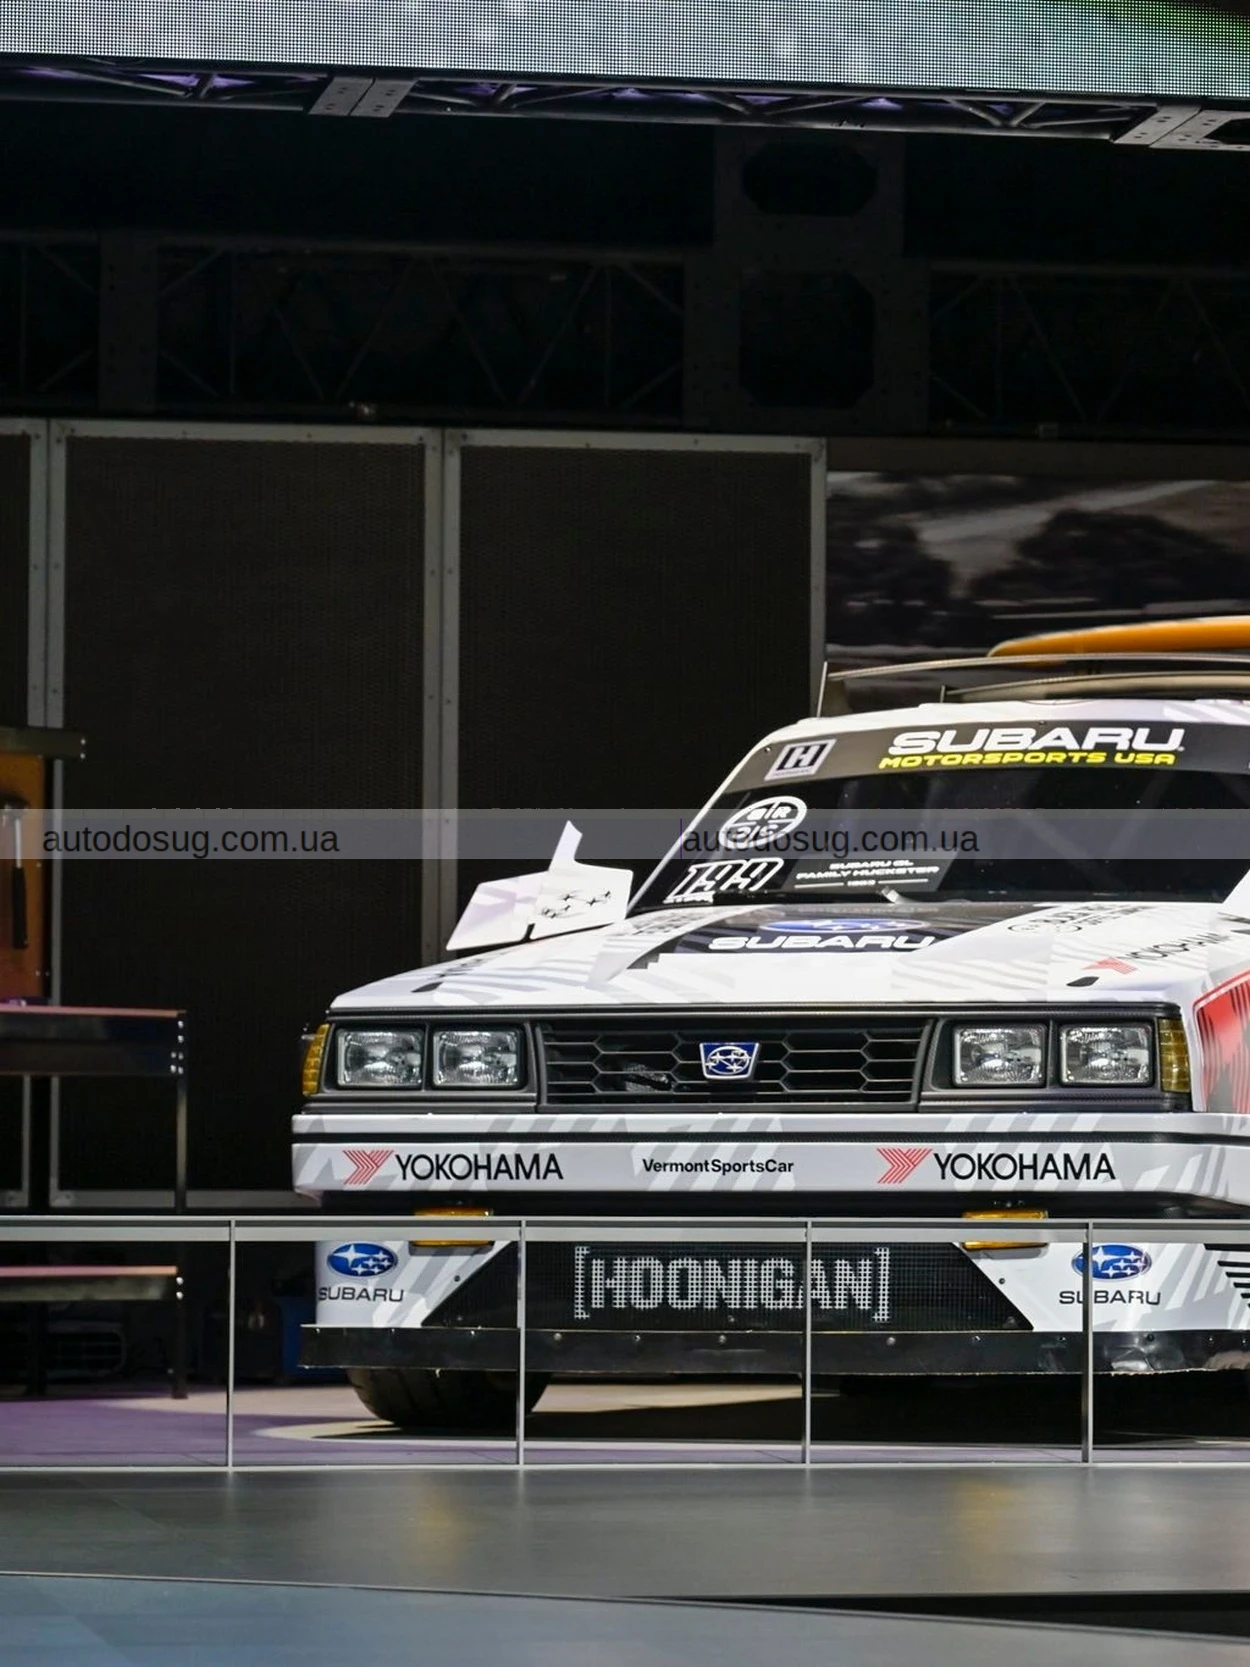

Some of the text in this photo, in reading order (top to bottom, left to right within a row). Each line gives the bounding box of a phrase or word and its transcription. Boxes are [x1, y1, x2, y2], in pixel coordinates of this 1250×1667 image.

[888, 727, 1184, 755] SUBARU
[878, 751, 1176, 769] MOTORSPORTS USA
[795, 869, 851, 879] FAMILY
[708, 934, 936, 951] SUBARU
[395, 1152, 564, 1181] YOKOHAMA
[933, 1152, 1116, 1180] YOKOHAMA
[318, 1286, 405, 1303] SUBARU
